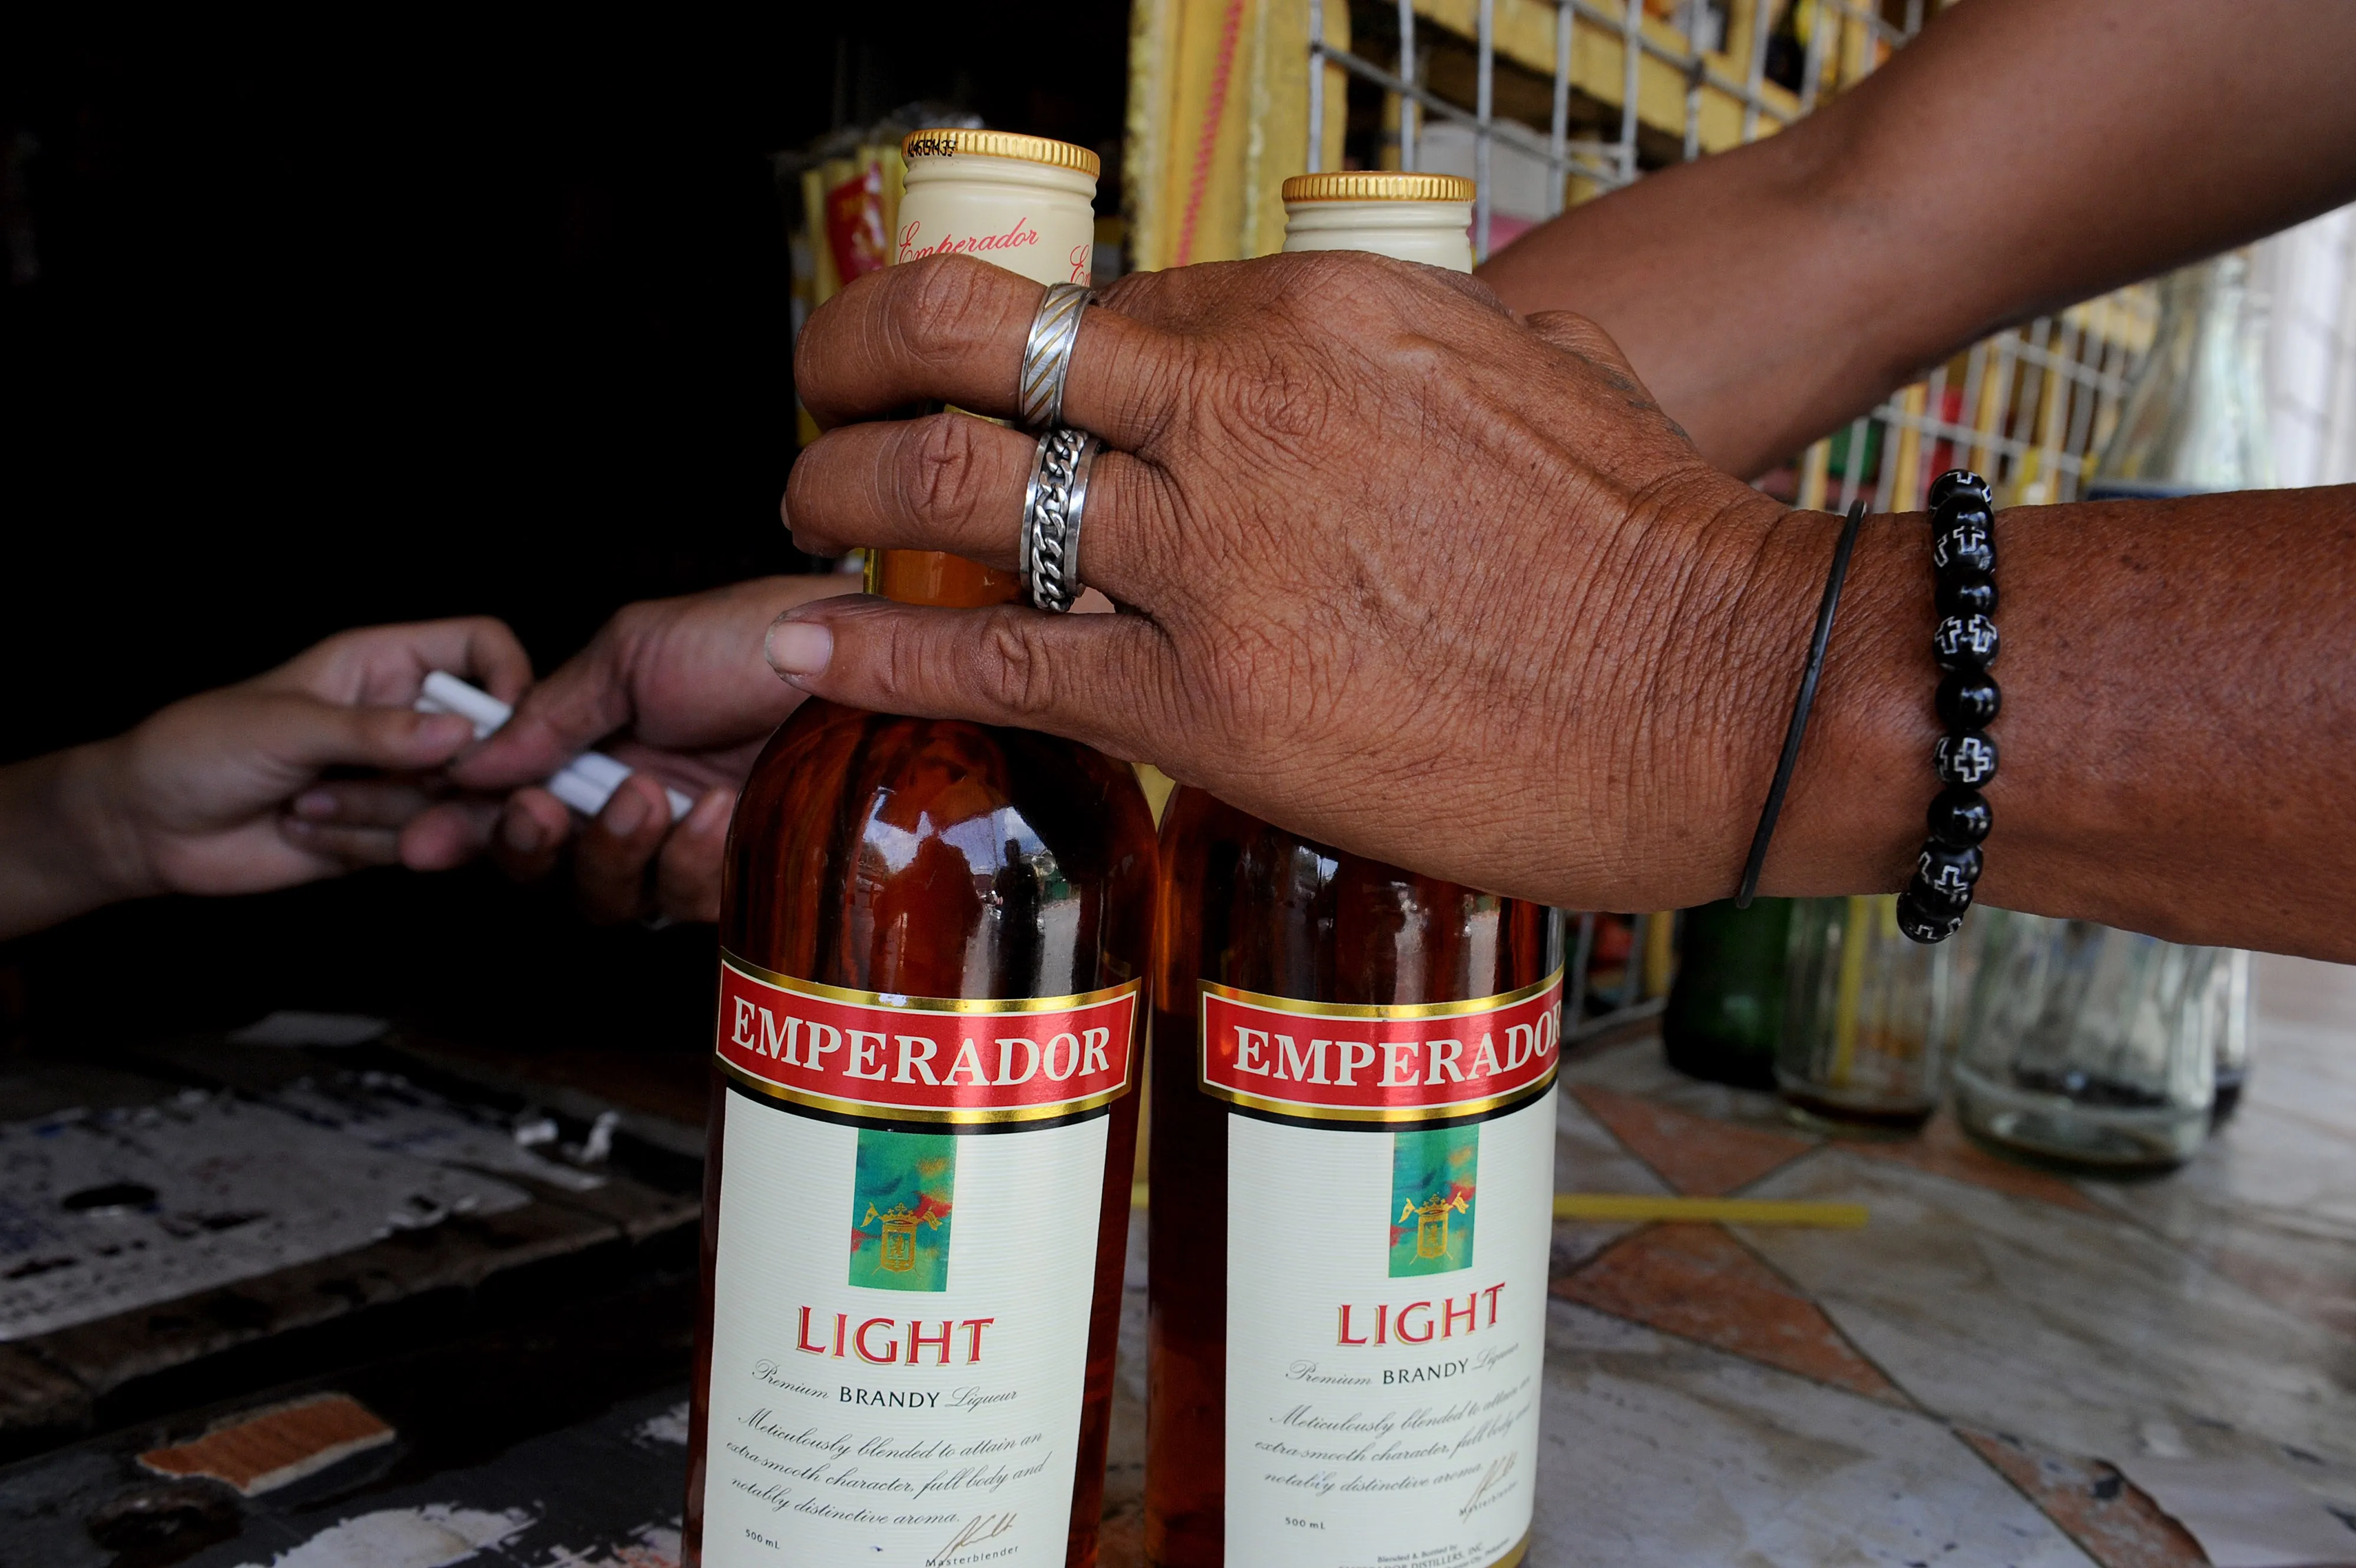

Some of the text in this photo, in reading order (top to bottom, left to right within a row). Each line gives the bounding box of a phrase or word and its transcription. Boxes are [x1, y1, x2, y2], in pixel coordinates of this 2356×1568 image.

[731, 995, 1110, 1087] EMPERADOR
[1233, 999, 1561, 1087] EMPERADOR
[796, 1305, 995, 1367] LIGHT
[1336, 1282, 1506, 1347] LIGHT
[752, 1358, 1018, 1413] Premium BRANDY Liqueur
[1285, 1359, 1373, 1386] Premium
[1383, 1357, 1470, 1385] BRANDY
[737, 1407, 1043, 1460] Meticulously blended to attain an
[1269, 1404, 1397, 1440] Meticulously
[1401, 1400, 1472, 1430] blended
[913, 1466, 975, 1500] full
[966, 1464, 1009, 1493] body
[1012, 1451, 1053, 1480] and
[1340, 1475, 1430, 1492] distinctive
[731, 1477, 792, 1512] notably
[794, 1497, 889, 1524] distinctive
[1285, 1516, 1306, 1528] 500
[745, 1529, 781, 1550] 500 mL
[925, 1545, 1018, 1568] Masterblender
